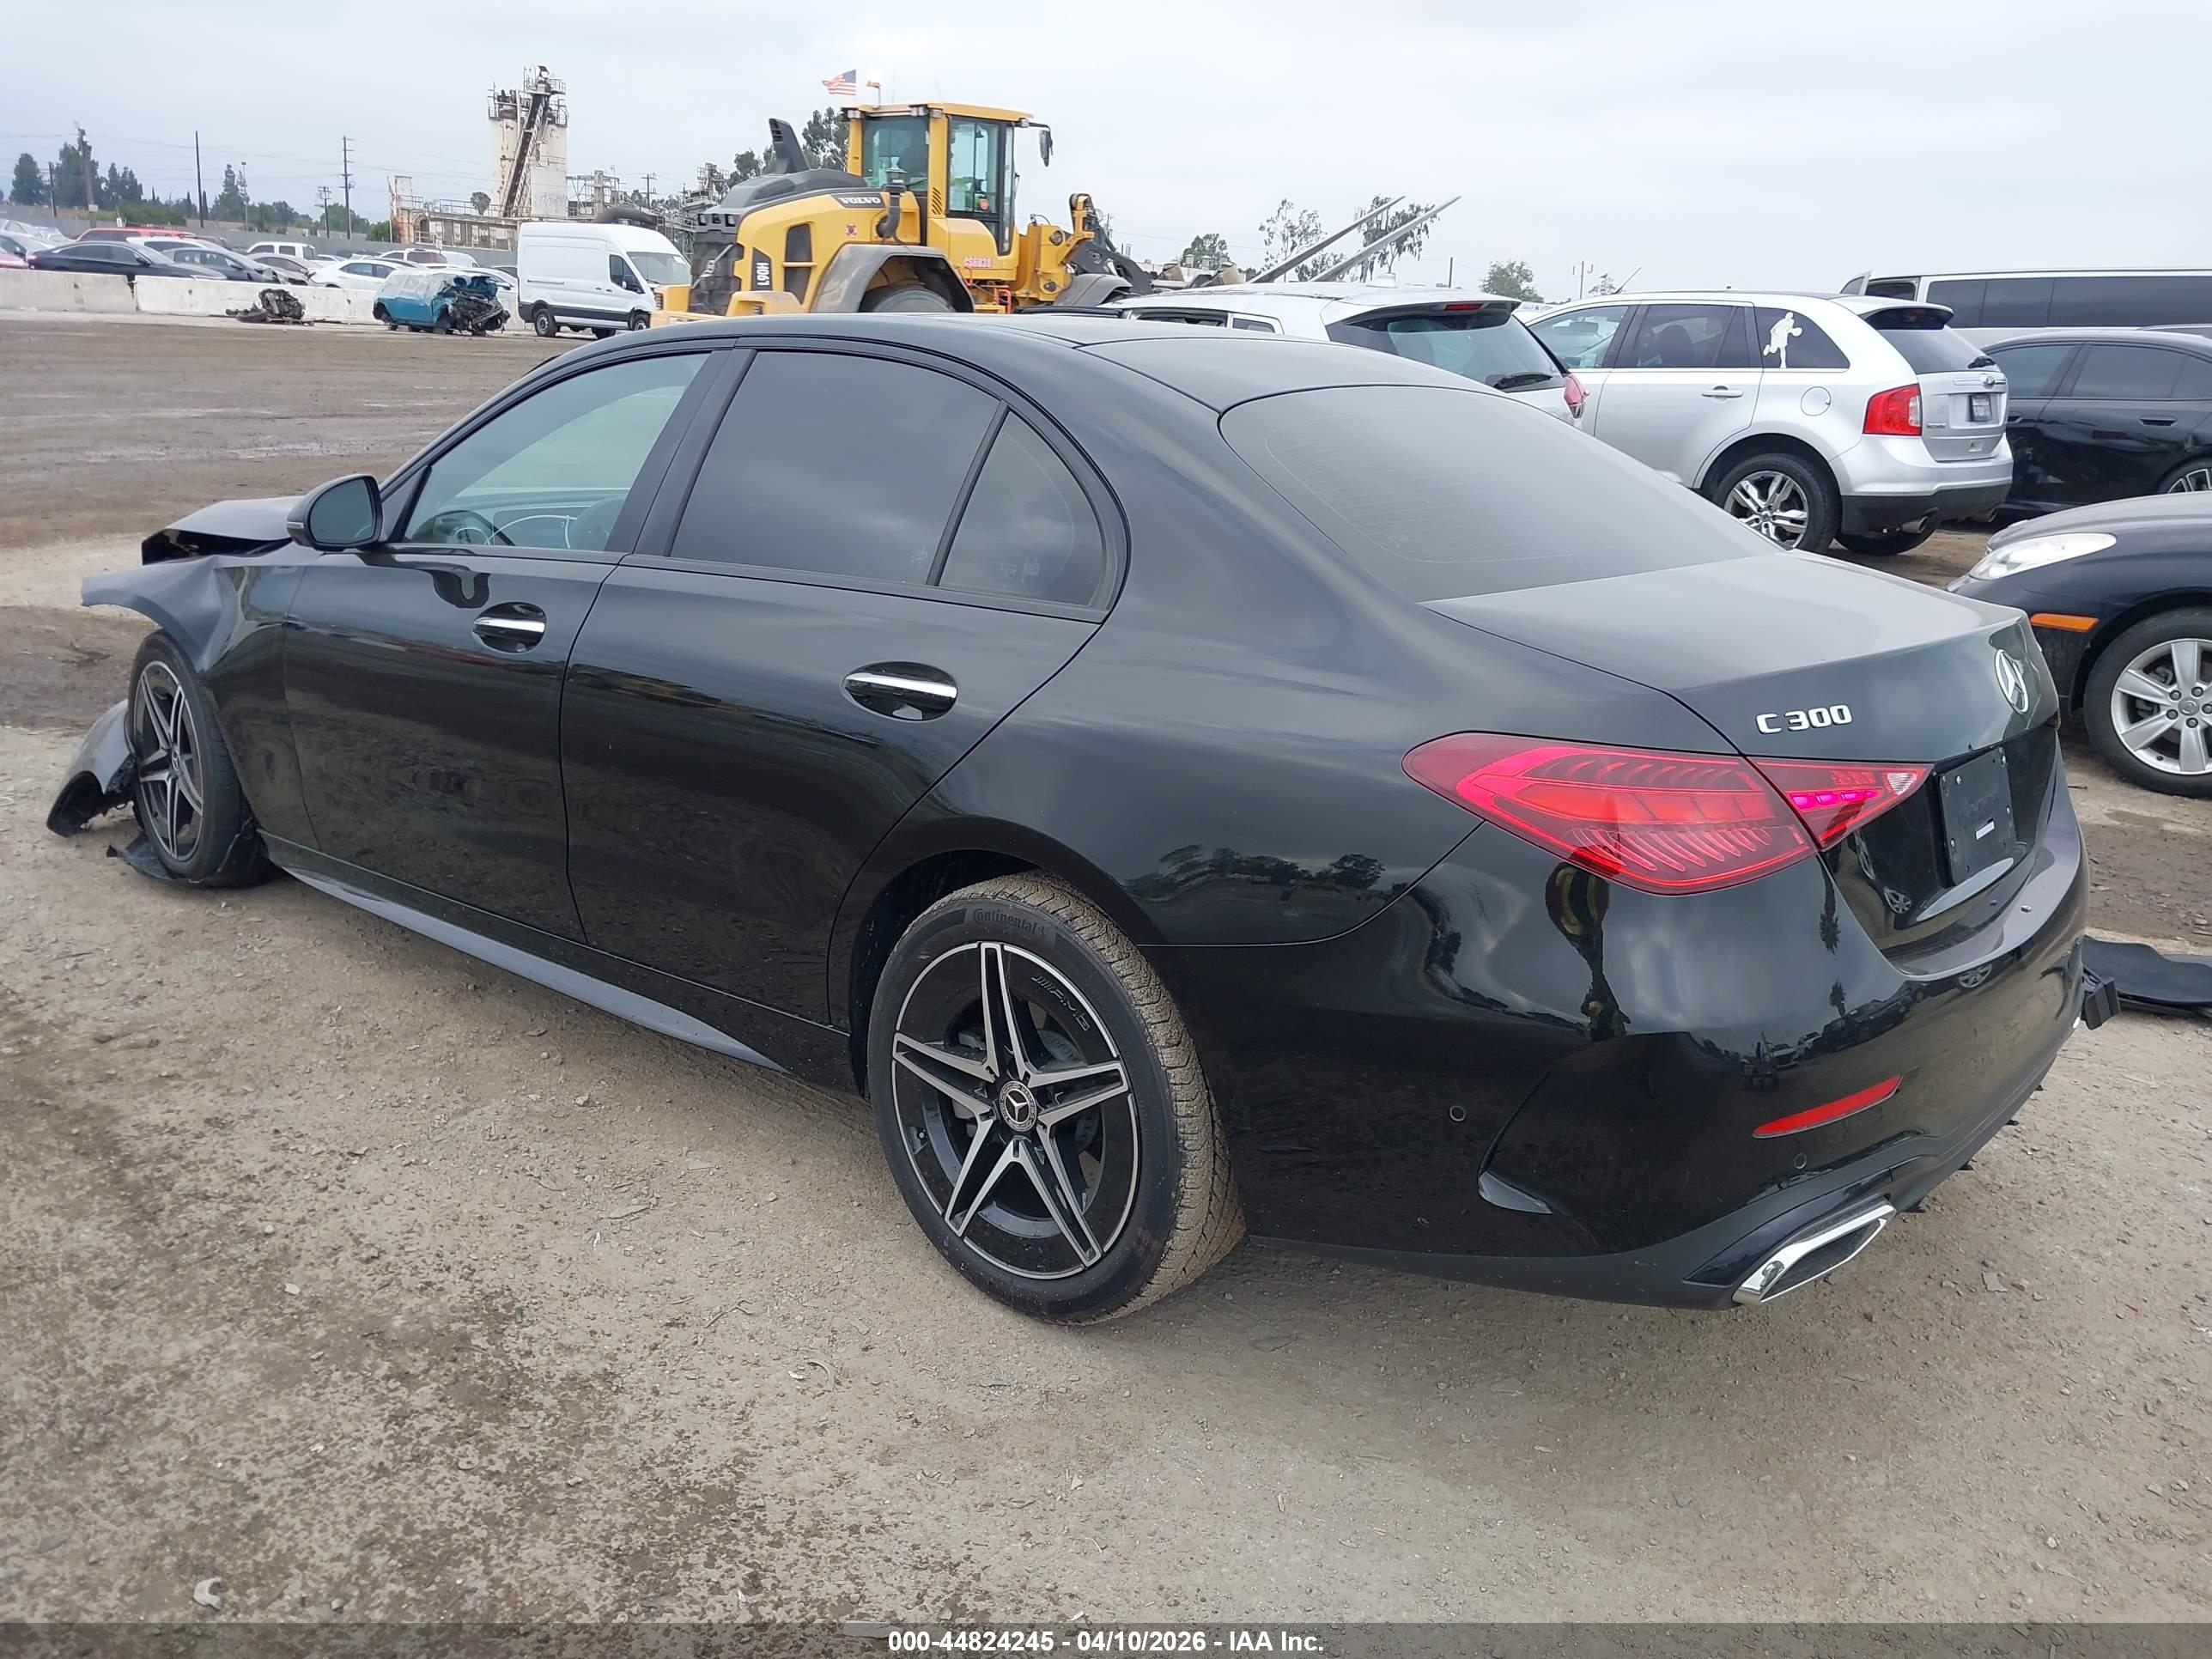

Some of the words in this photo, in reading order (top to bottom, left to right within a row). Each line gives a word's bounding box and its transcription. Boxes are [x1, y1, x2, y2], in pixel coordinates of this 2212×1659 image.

[756, 262, 770, 286] L90H
[1756, 713, 1783, 734] C
[1785, 704, 1852, 731] 300
[973, 908, 1038, 933] Continental
